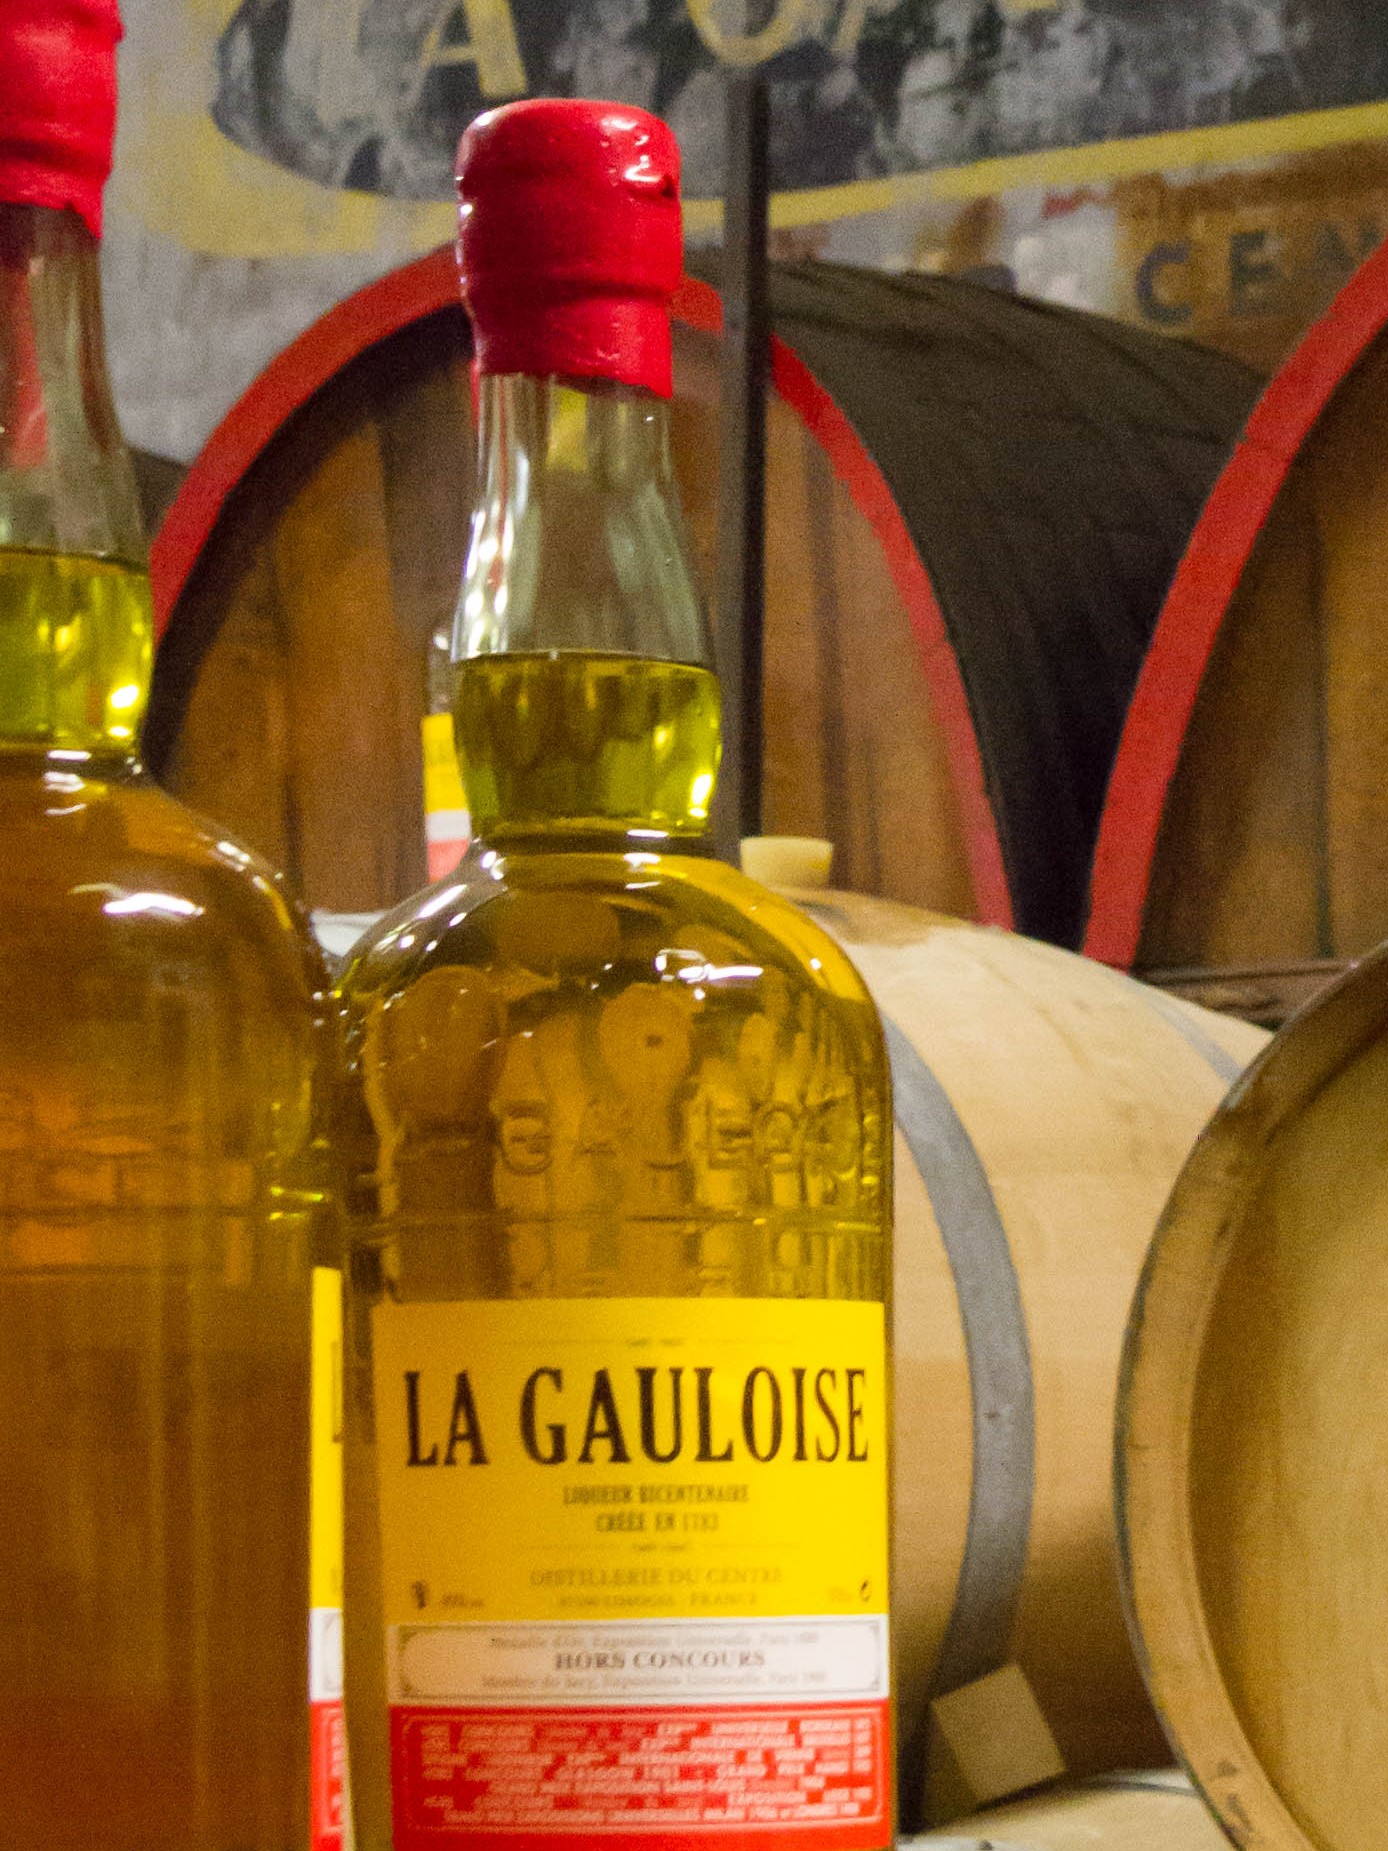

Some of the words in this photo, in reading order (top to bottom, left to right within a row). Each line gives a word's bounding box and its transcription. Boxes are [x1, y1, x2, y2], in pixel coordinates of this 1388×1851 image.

[404, 1370, 490, 1466] LA
[519, 1367, 868, 1465] GAULOISE
[530, 1567, 661, 1586] DISTILLERIE
[669, 1567, 700, 1585] DU
[705, 1566, 783, 1584] CENTRE
[555, 1651, 625, 1671] HORS
[632, 1649, 765, 1670] CONCOURS
